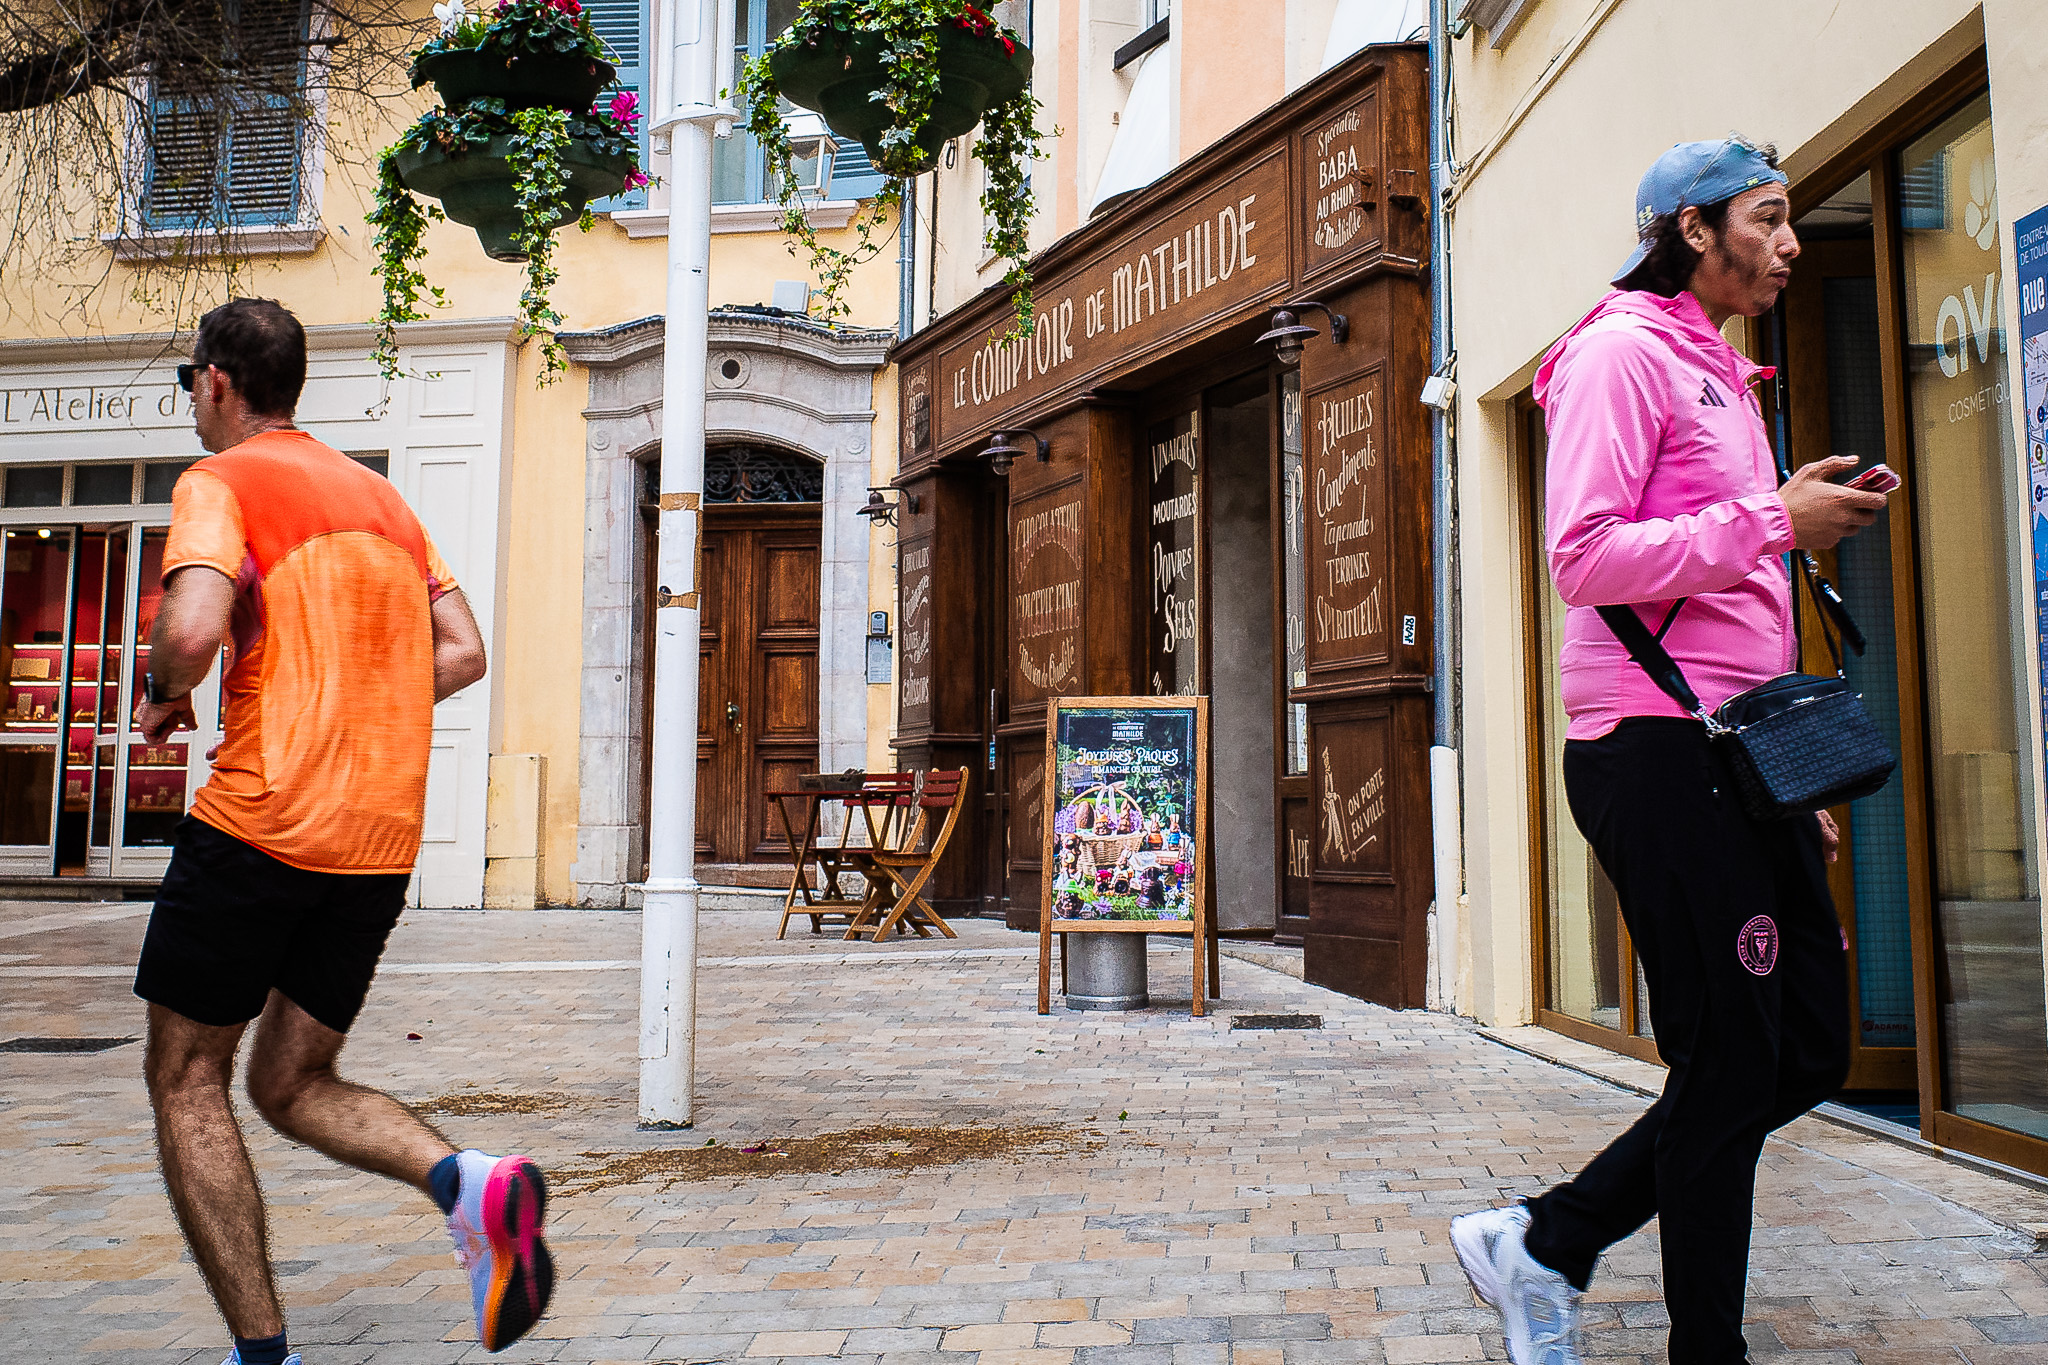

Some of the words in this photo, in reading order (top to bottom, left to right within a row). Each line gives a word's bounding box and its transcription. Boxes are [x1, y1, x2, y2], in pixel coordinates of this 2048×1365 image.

[1319, 144, 1359, 190] BABA
[1314, 222, 1325, 246] de
[1324, 208, 1362, 249] Mathilde
[1316, 195, 1329, 222] AU
[2020, 249, 2030, 266] DE
[953, 366, 967, 410] LE
[971, 297, 1074, 406] COMPTOIR
[1084, 288, 1106, 339] DE
[1112, 193, 1257, 334] MATHILDE
[5, 387, 142, 422] L'Atelier
[1317, 389, 1374, 458] HUILES
[1152, 430, 1197, 484] VINAIGRES
[1315, 433, 1377, 519] Condiments
[1153, 490, 1197, 525] MOUTARDES
[1316, 576, 1383, 644] SPIRITUEUX
[1112, 730, 1144, 738] MATHILDE
[1091, 765, 1131, 774] DIMANCHE
[1141, 765, 1163, 774] AVRIL
[1347, 792, 1361, 817] ON
[1360, 767, 1385, 805] PORTE
[1350, 815, 1364, 841] EN
[1362, 794, 1386, 829] VILLE
